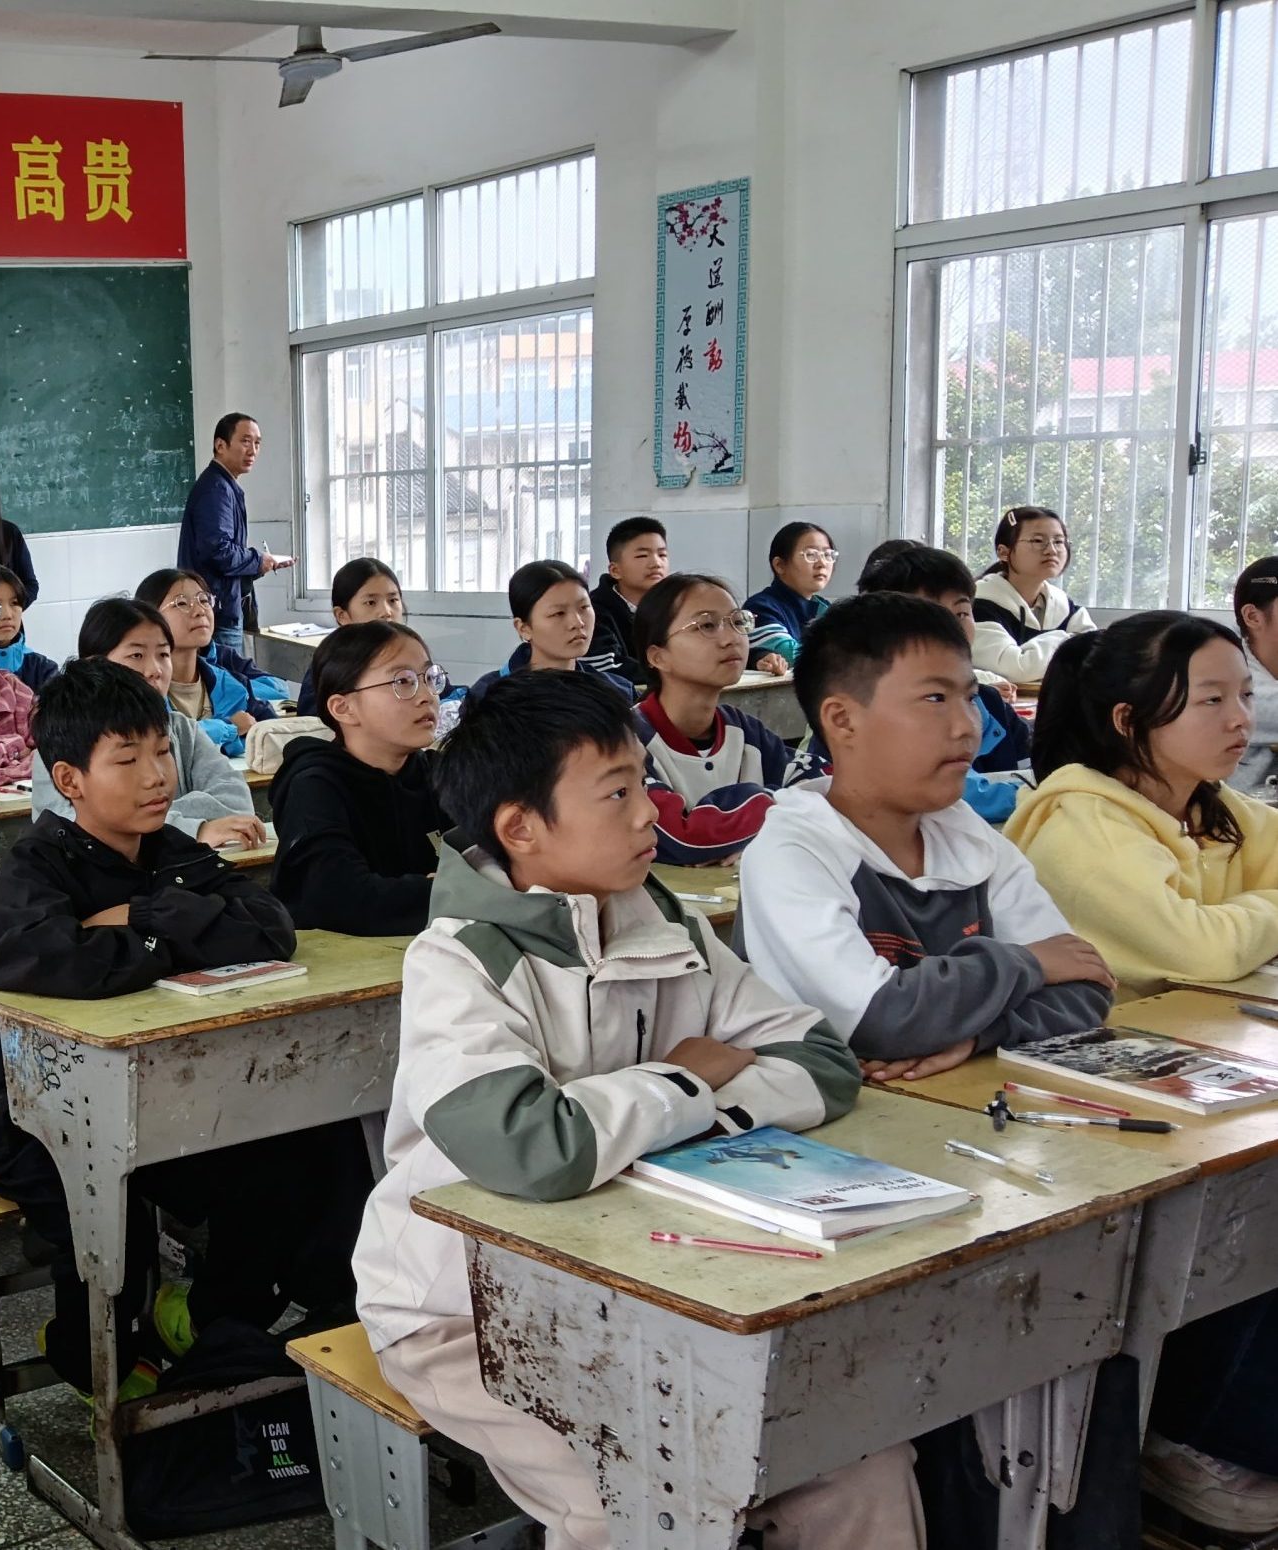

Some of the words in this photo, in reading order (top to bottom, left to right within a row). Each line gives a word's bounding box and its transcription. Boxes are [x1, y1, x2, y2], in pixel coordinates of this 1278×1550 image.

[262, 1424, 267, 1438] I
[269, 1422, 290, 1436] CAN
[271, 1439, 287, 1452] DO
[273, 1454, 294, 1466] ALL
[268, 1464, 310, 1479] THINGS
